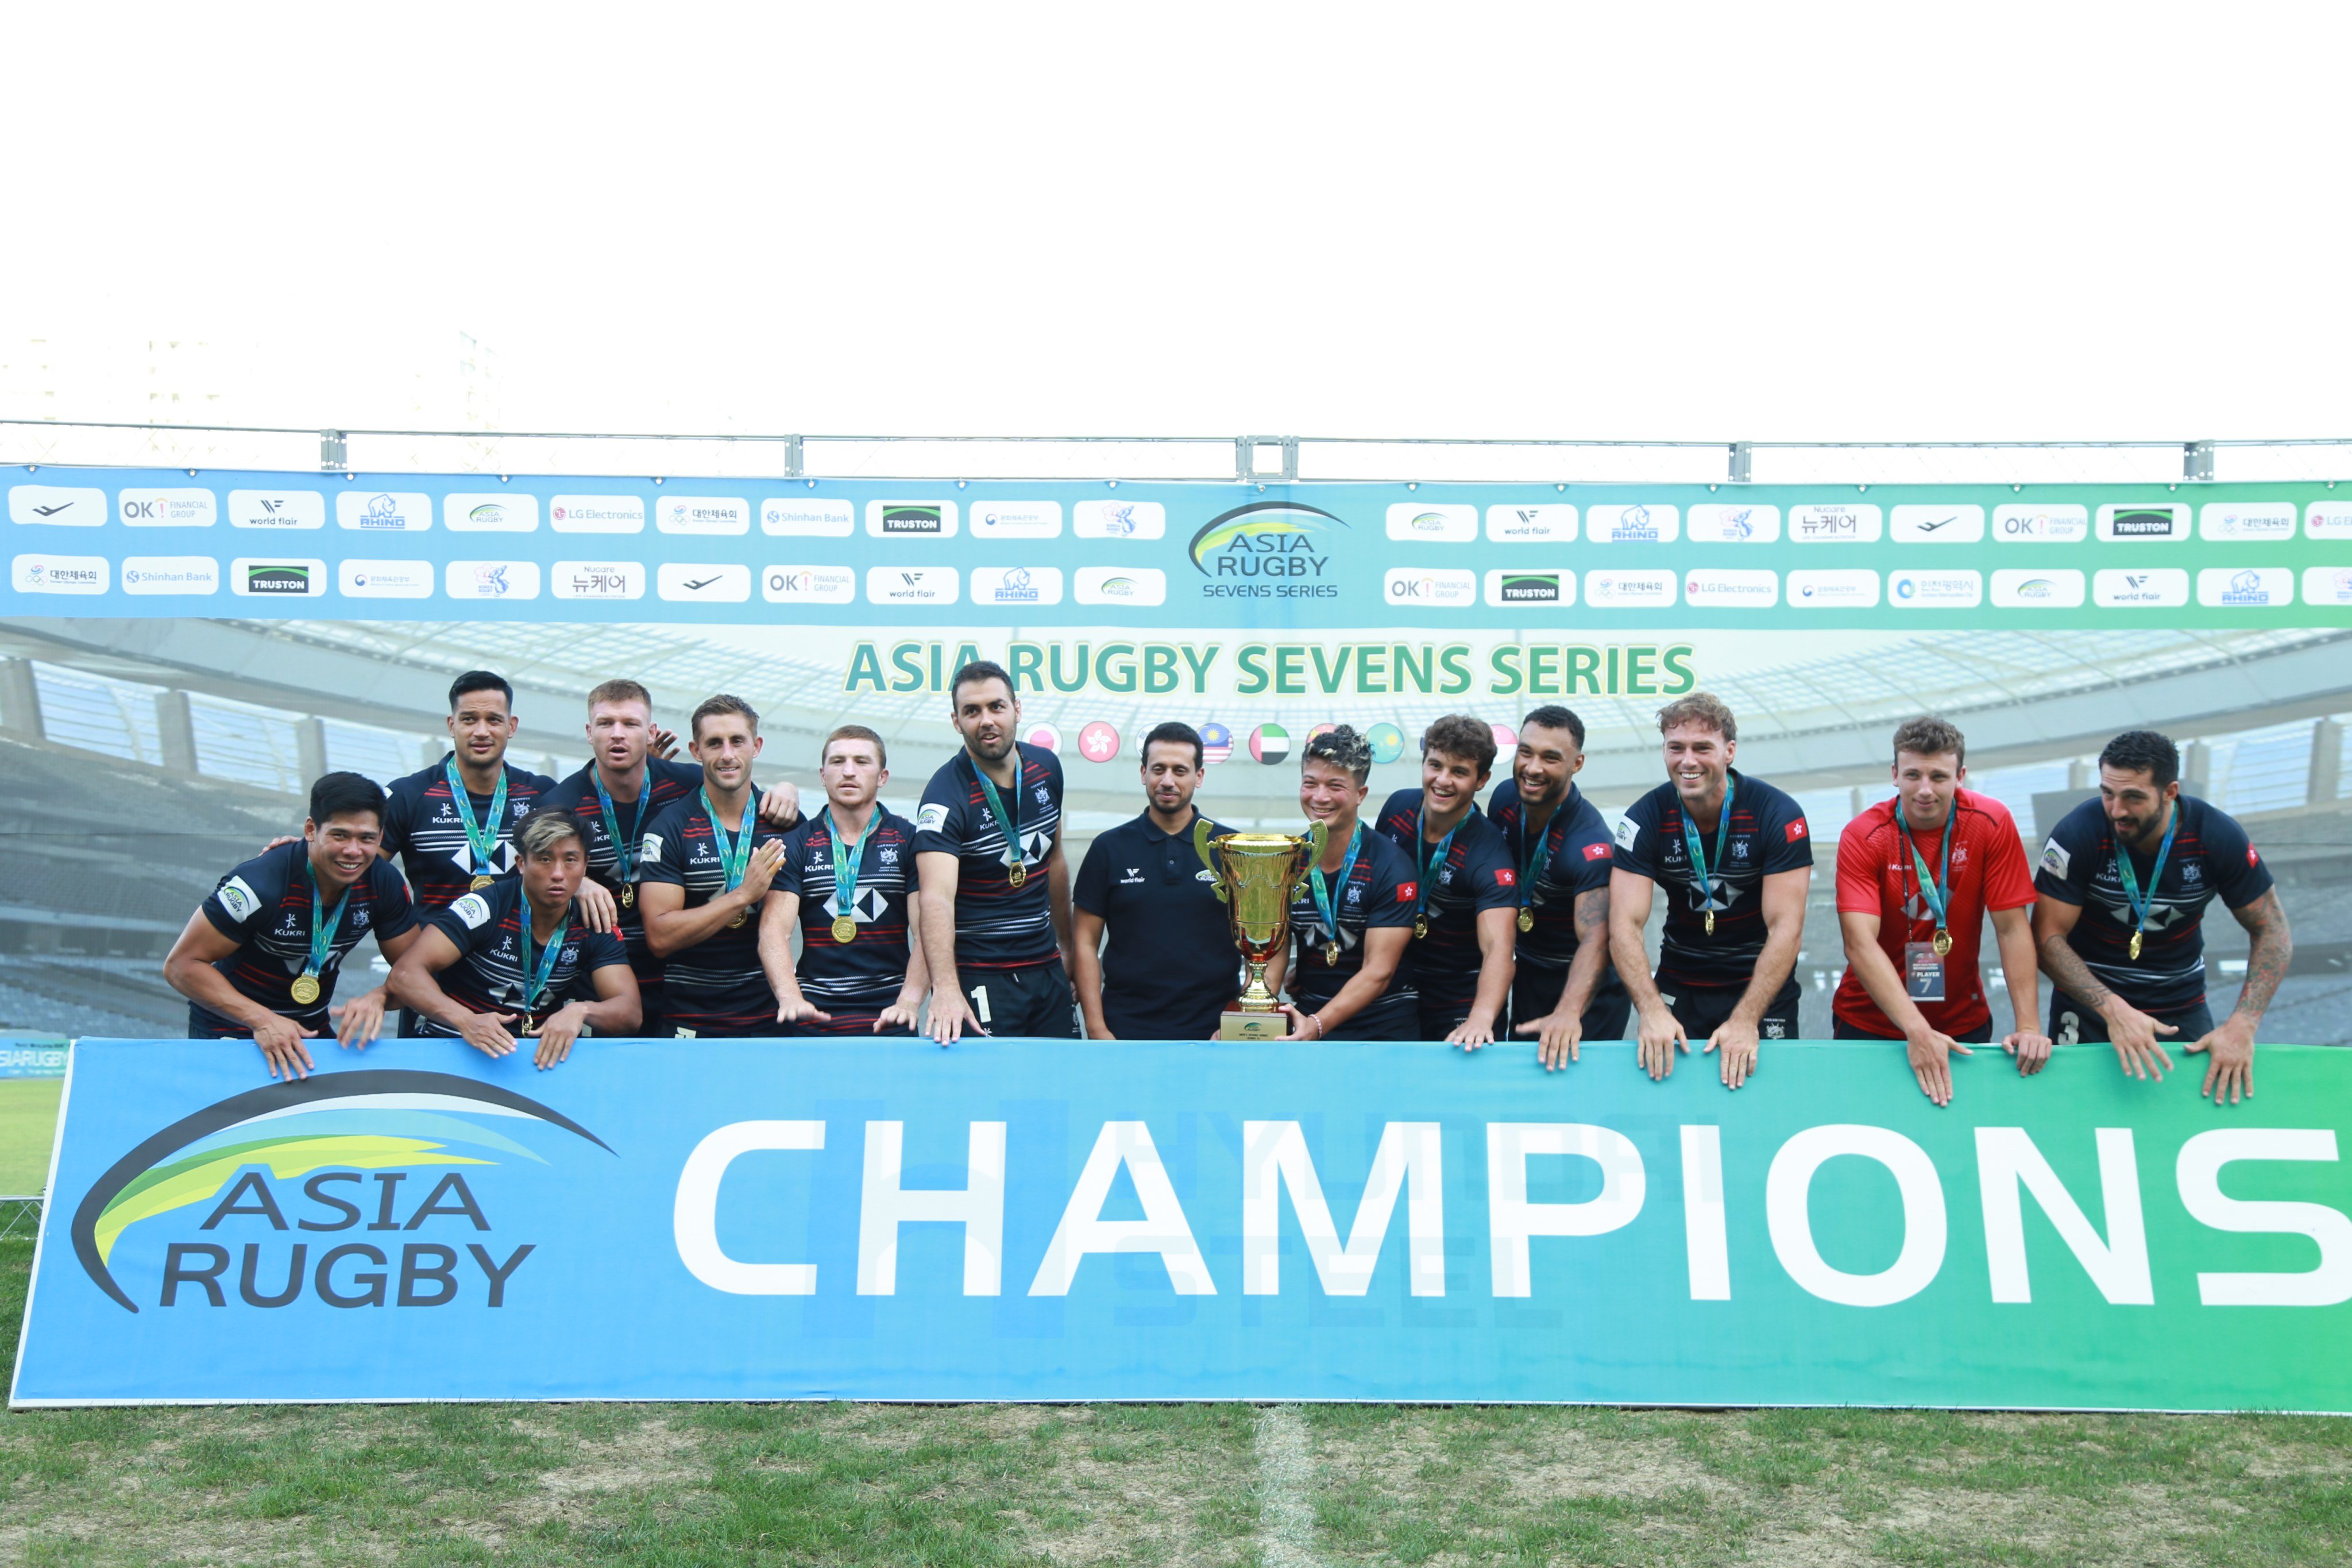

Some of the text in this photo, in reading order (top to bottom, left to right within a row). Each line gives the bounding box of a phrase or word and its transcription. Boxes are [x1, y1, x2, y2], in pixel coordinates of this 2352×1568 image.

[169, 501, 208, 509] FINANCIAL
[1814, 505, 1846, 513] Nucare
[569, 509, 643, 520] LG Electronics
[782, 512, 849, 523] Shinhan Bank
[249, 516, 298, 526] world flair
[360, 517, 405, 527] RHINO
[887, 519, 937, 529] TRUSTON
[1802, 515, 1856, 534] 뉴케어
[2327, 516, 2341, 525] LG
[1504, 527, 1551, 535] world flair
[2117, 523, 2169, 532] TRUSTON
[1612, 531, 1659, 539] RHINO
[1227, 534, 1315, 553] ASIA
[1217, 556, 1330, 577] RUGBY
[142, 571, 213, 581] Shinhan Bank
[813, 575, 850, 583] FINANCIAL
[253, 580, 305, 590] TRUSTON
[573, 575, 626, 593] 뉴케어
[813, 584, 838, 592] GROUP
[1435, 581, 1471, 589] FINANCIAL
[1701, 583, 1772, 593] LG Electronics
[889, 590, 936, 598] world flair
[995, 590, 1038, 598] RHINO
[1203, 584, 1338, 598] SEVENS SERIES
[1435, 590, 1459, 598] GROUP
[1505, 589, 1556, 598] TRUSTON
[2113, 592, 2161, 601] world flair
[845, 643, 1696, 695] ASIA RUGBY SEVENS SERIES
[690, 856, 720, 864] KUKRI
[805, 864, 833, 873] KUKRI
[225, 893, 242, 913] RUGBY
[230, 891, 242, 907] ASIA
[459, 901, 475, 920] RUGBY
[464, 900, 476, 915] ASIA
[274, 928, 306, 937] KUKRI
[489, 948, 518, 963] KUKRI
[1920, 978, 1933, 994] 7
[970, 985, 992, 1023] 1
[2057, 1011, 2079, 1045] 3
[199, 1172, 492, 1232] ASIA
[673, 1119, 2352, 1308] CHAMPIONS
[159, 1242, 537, 1308] RUGBY
